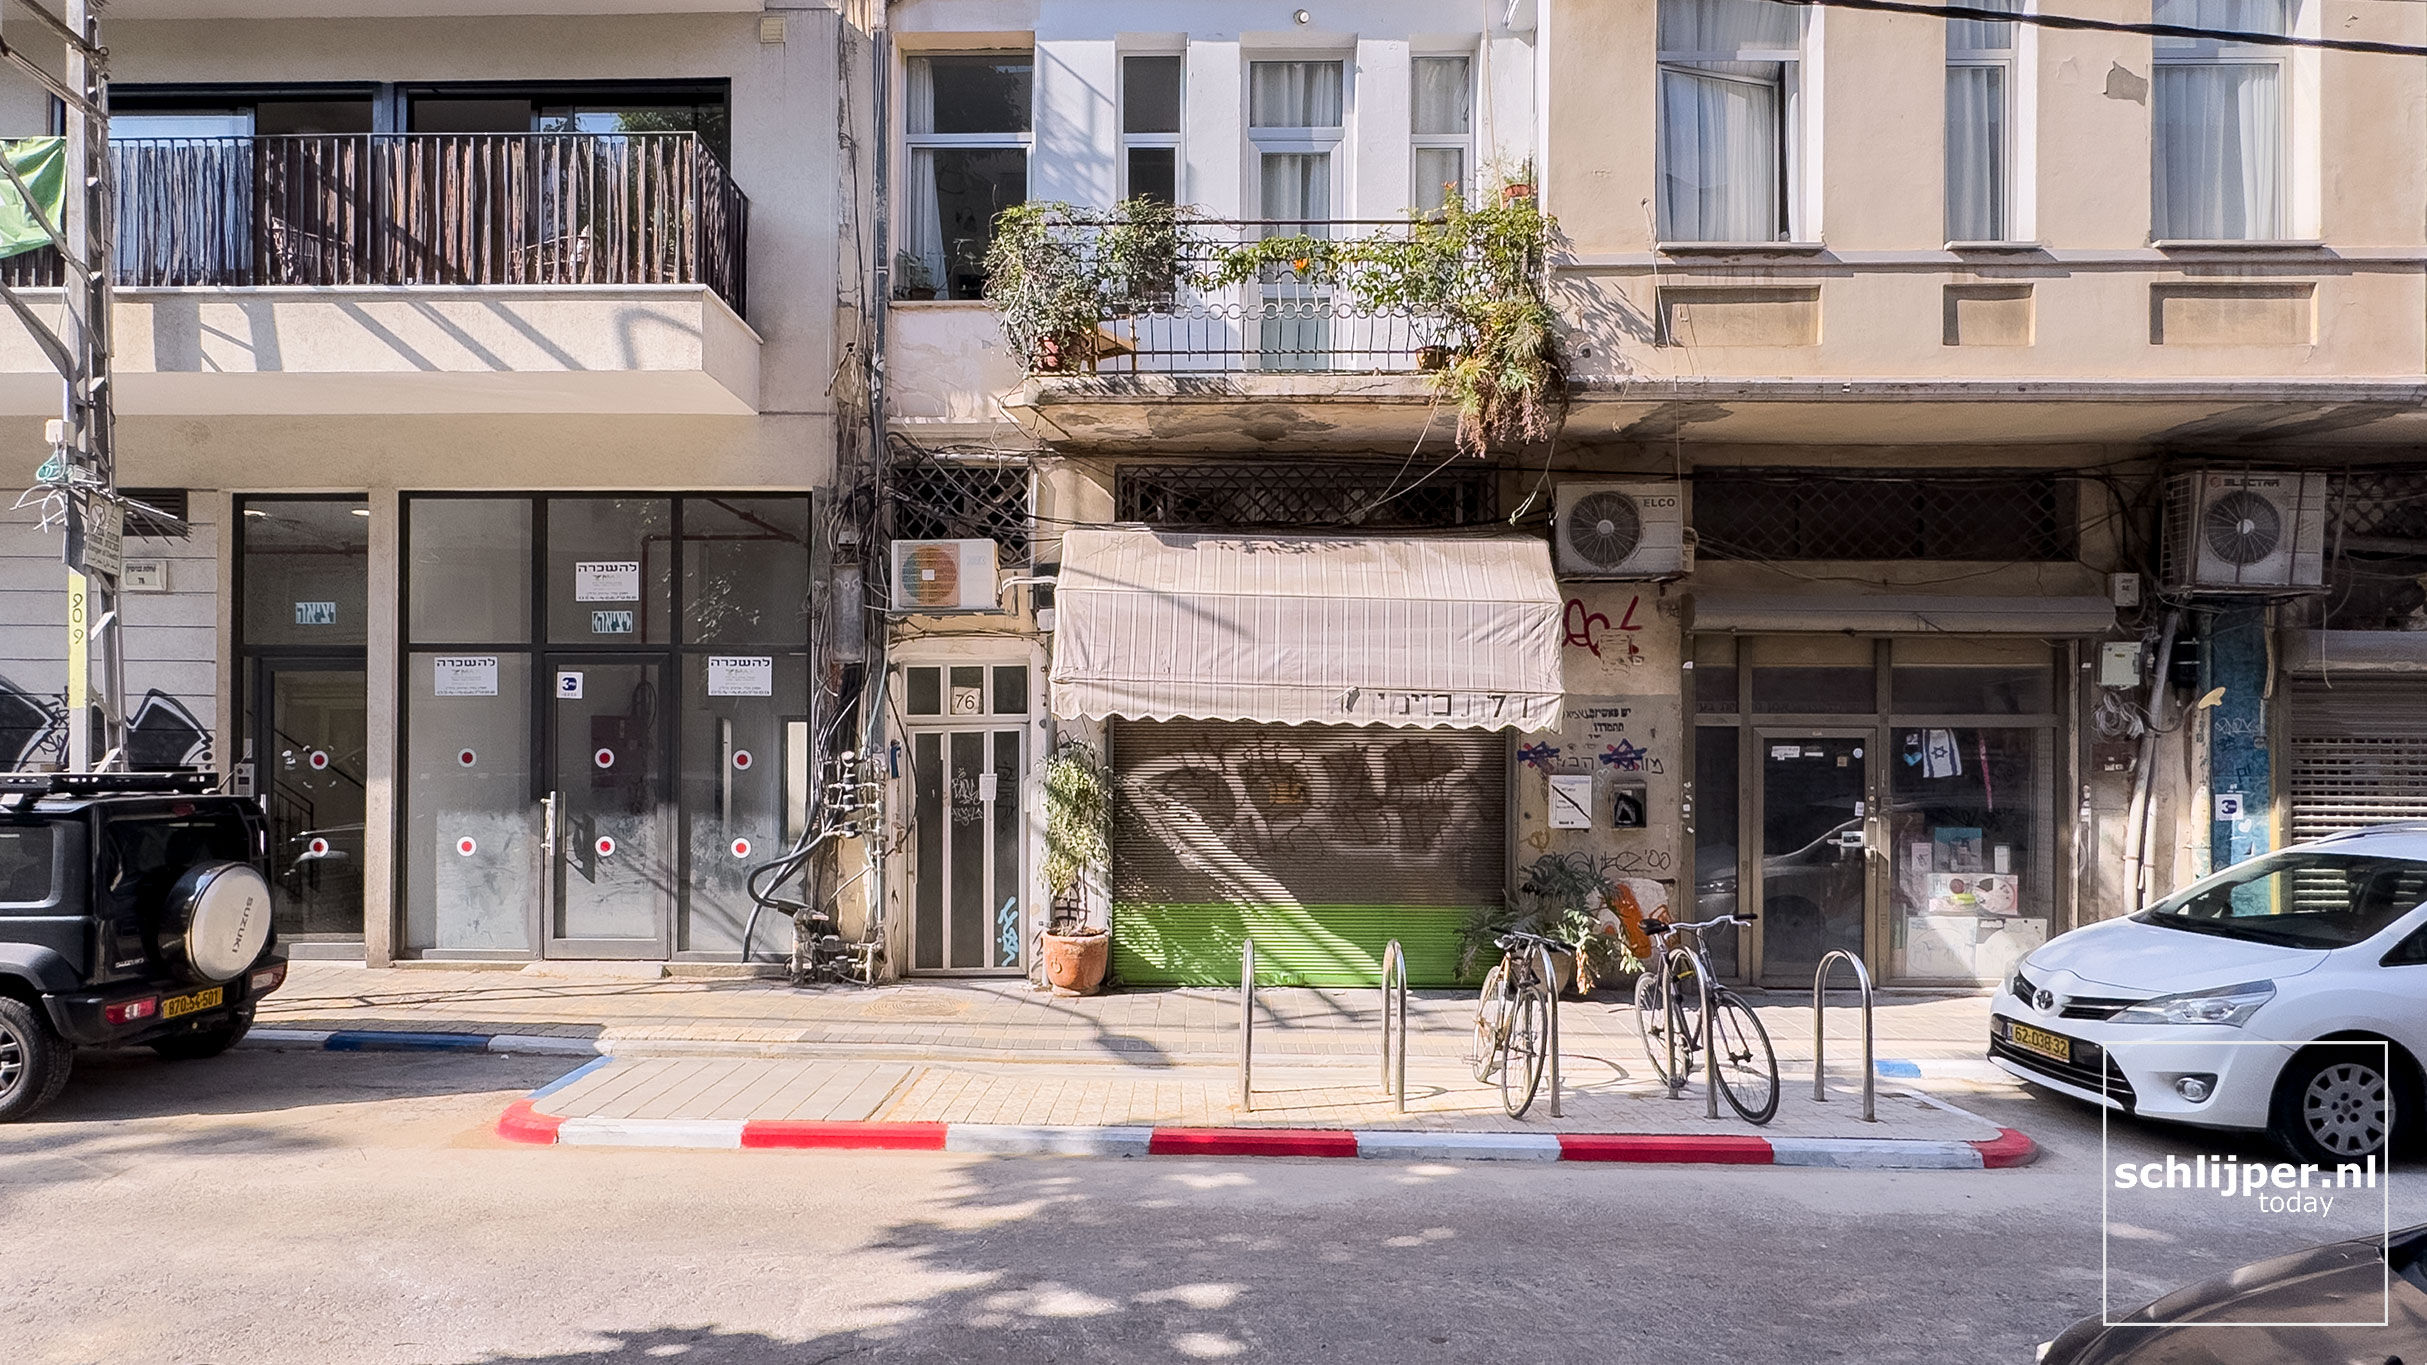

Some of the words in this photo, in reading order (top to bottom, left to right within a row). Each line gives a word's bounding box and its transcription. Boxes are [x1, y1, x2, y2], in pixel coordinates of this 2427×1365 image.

[2223, 478, 2280, 487] ELCTRA
[1643, 498, 1676, 508] ELCO
[578, 563, 637, 573] להשכרה
[437, 658, 496, 667] להשכרה
[711, 658, 770, 667] להשכרה
[955, 694, 975, 710] 76
[232, 896, 254, 953] SUZUKI
